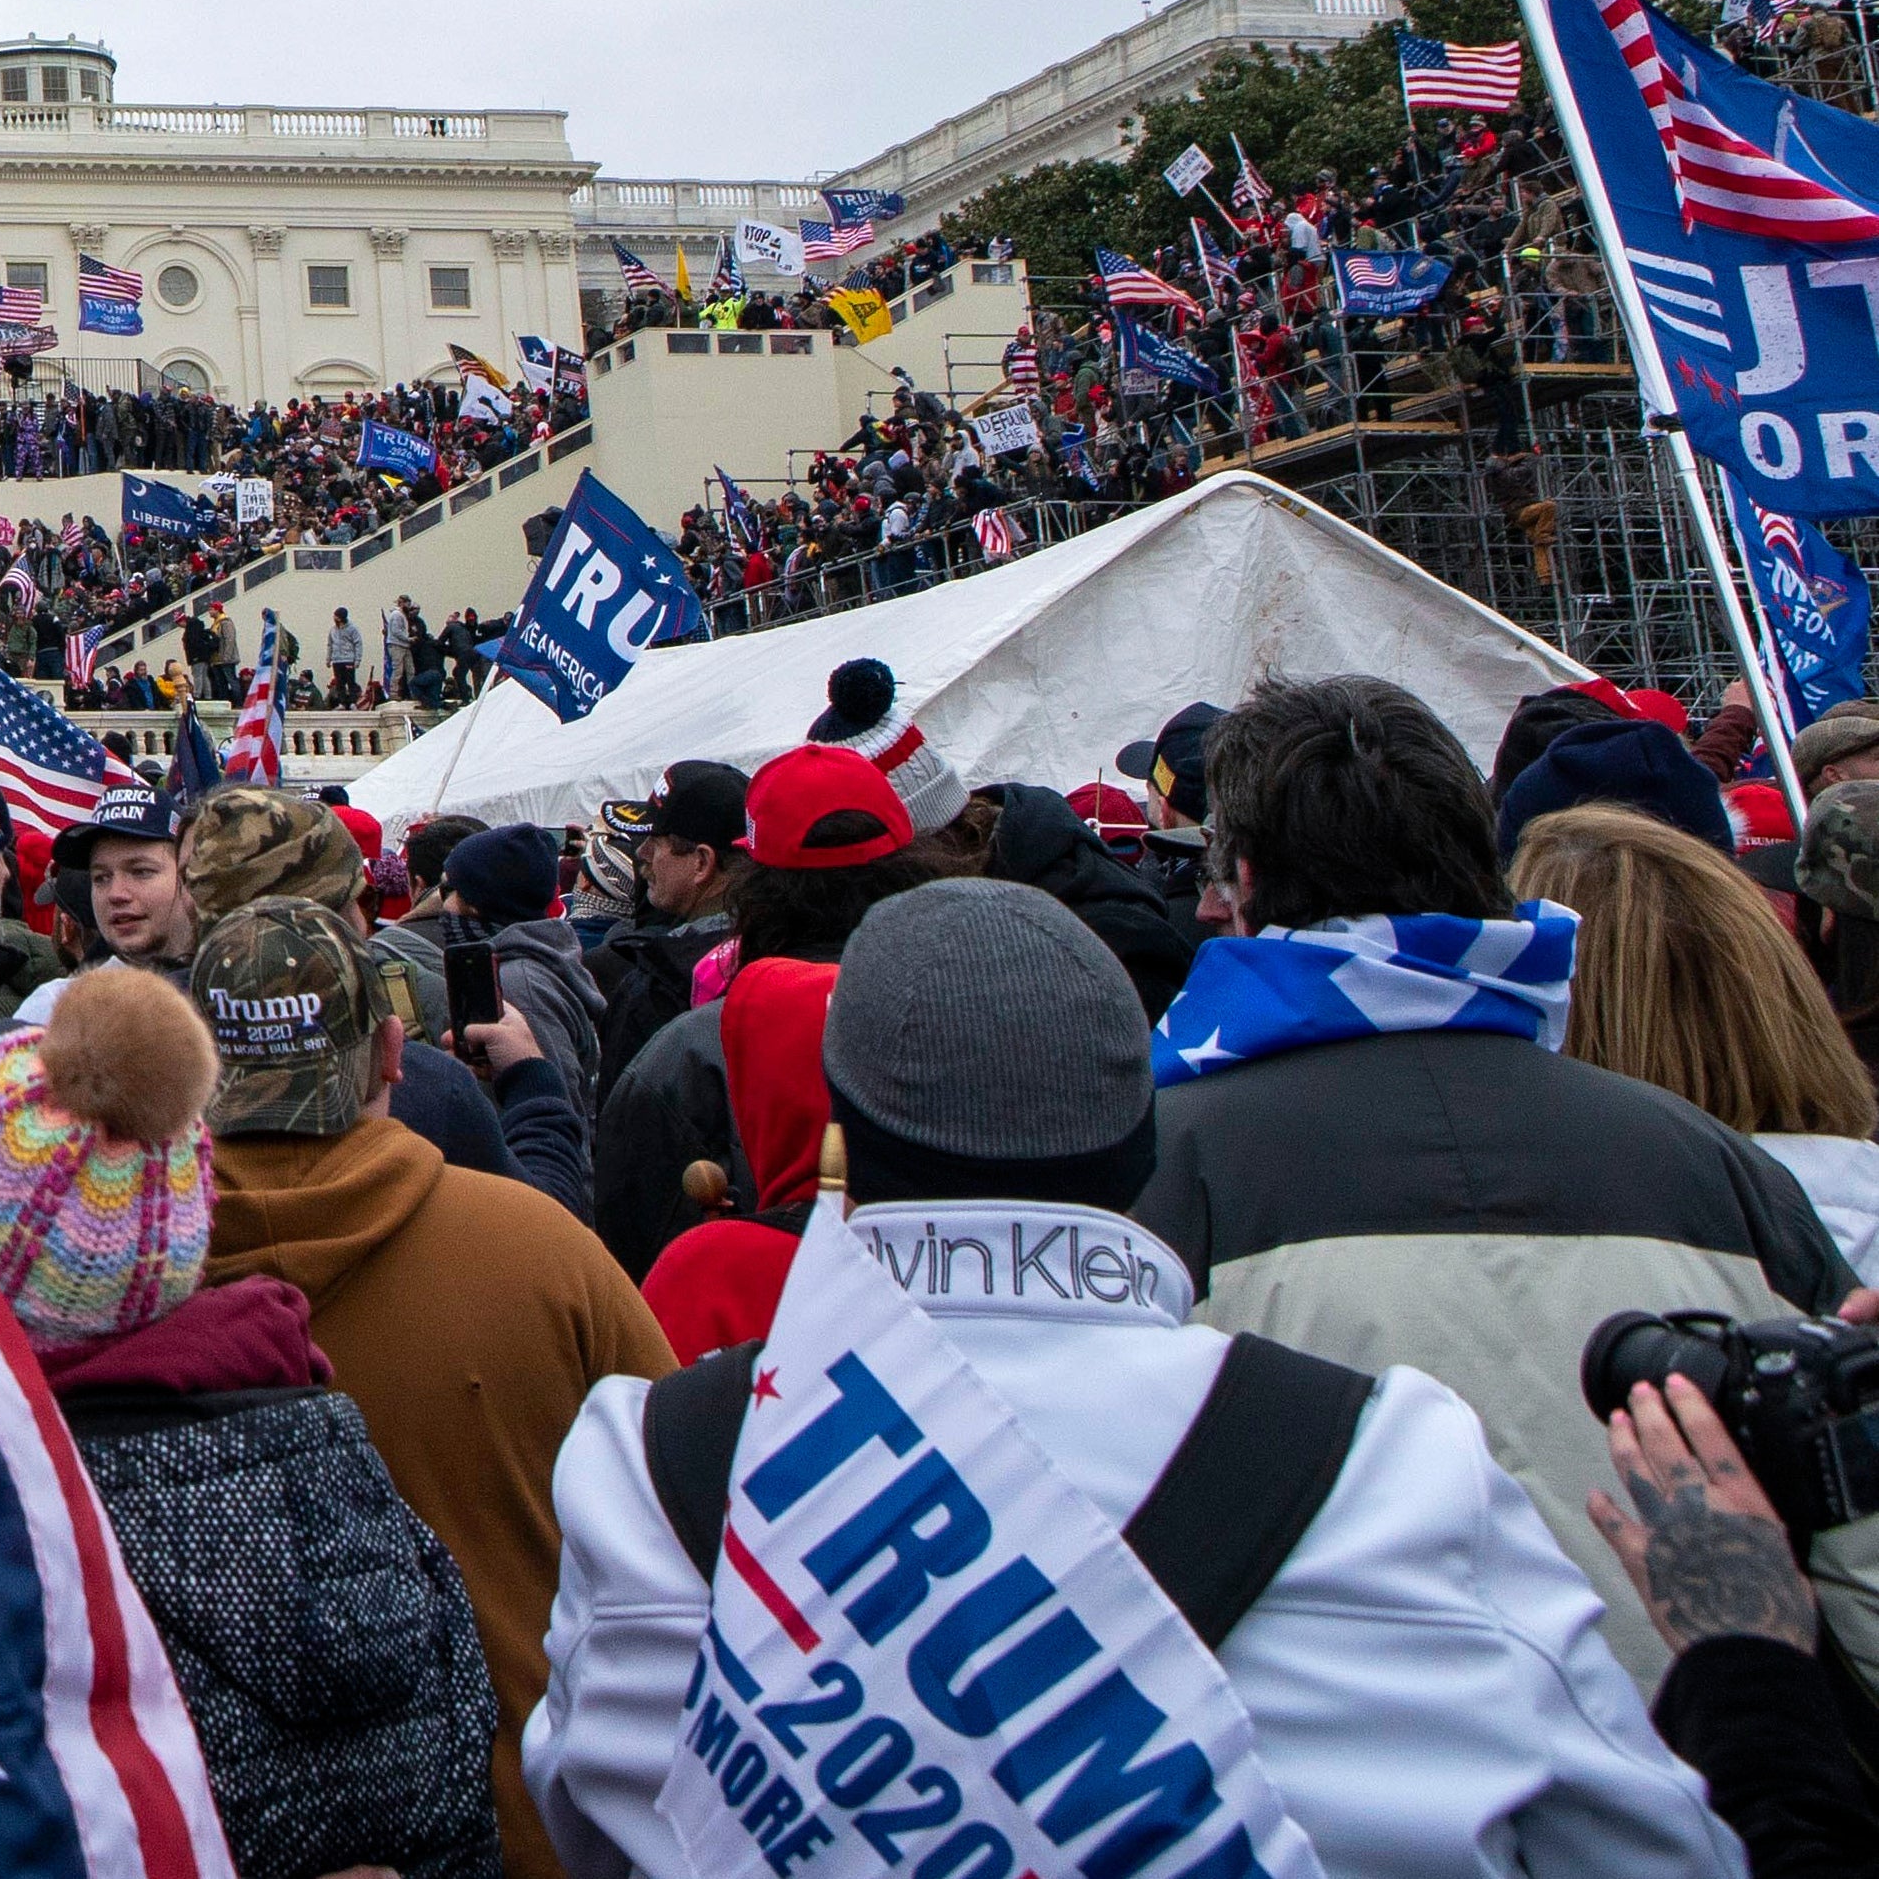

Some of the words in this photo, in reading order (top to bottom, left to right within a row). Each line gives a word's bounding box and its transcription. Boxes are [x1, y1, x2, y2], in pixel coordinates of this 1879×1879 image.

[744, 224, 772, 244] STOP
[977, 407, 1030, 435] DEFUND
[994, 427, 1024, 443] THE
[374, 428, 431, 458] TRUMP
[991, 434, 1035, 455] MEDIA
[132, 509, 192, 534] LIBERTY
[538, 633, 604, 701] AMERICA
[102, 806, 145, 823] AGAIN
[209, 988, 322, 1028] Trump
[233, 1043, 266, 1056] MORE
[269, 1042, 299, 1054] BULL
[303, 1037, 327, 1051] SHIT
[247, 1023, 293, 1043] 2020
[1012, 1222, 1159, 1309] Klein
[742, 1347, 1271, 1879] TRUM
[755, 1659, 1016, 1879] 2020
[685, 1690, 836, 1879] MORE
